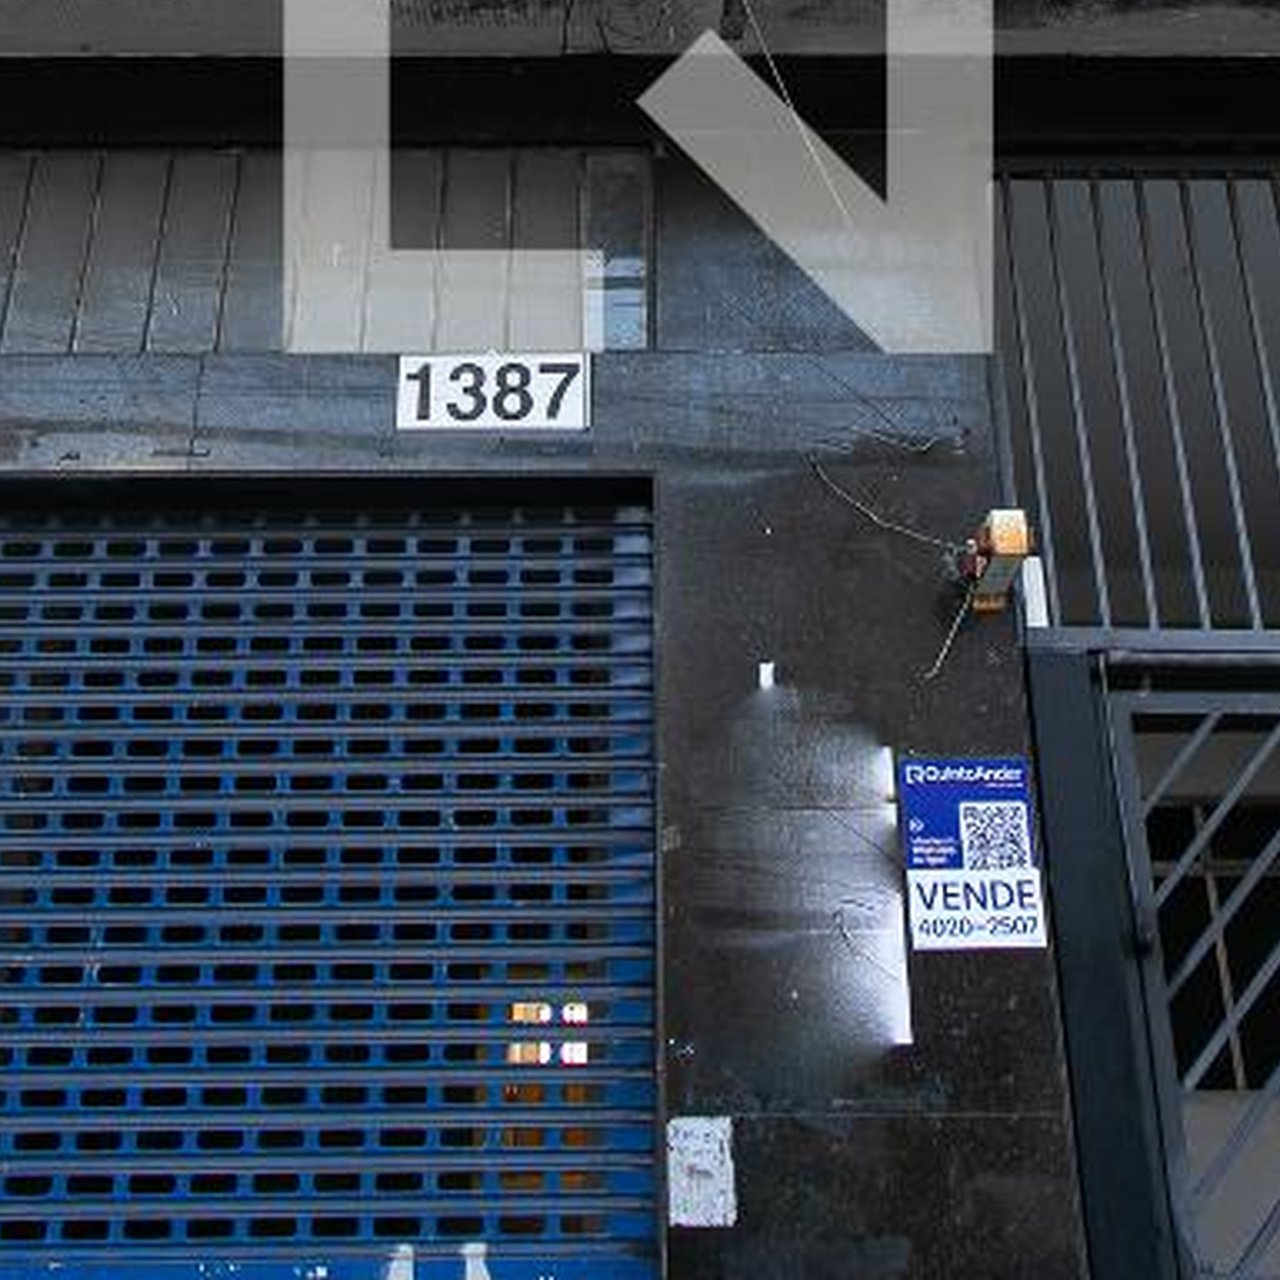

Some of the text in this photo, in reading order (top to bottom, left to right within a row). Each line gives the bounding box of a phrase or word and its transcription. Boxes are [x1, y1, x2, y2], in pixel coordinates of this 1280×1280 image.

[405, 362, 581, 422] 1387
[916, 879, 1037, 911] VENDE
[919, 917, 1038, 937] 4020-2507
